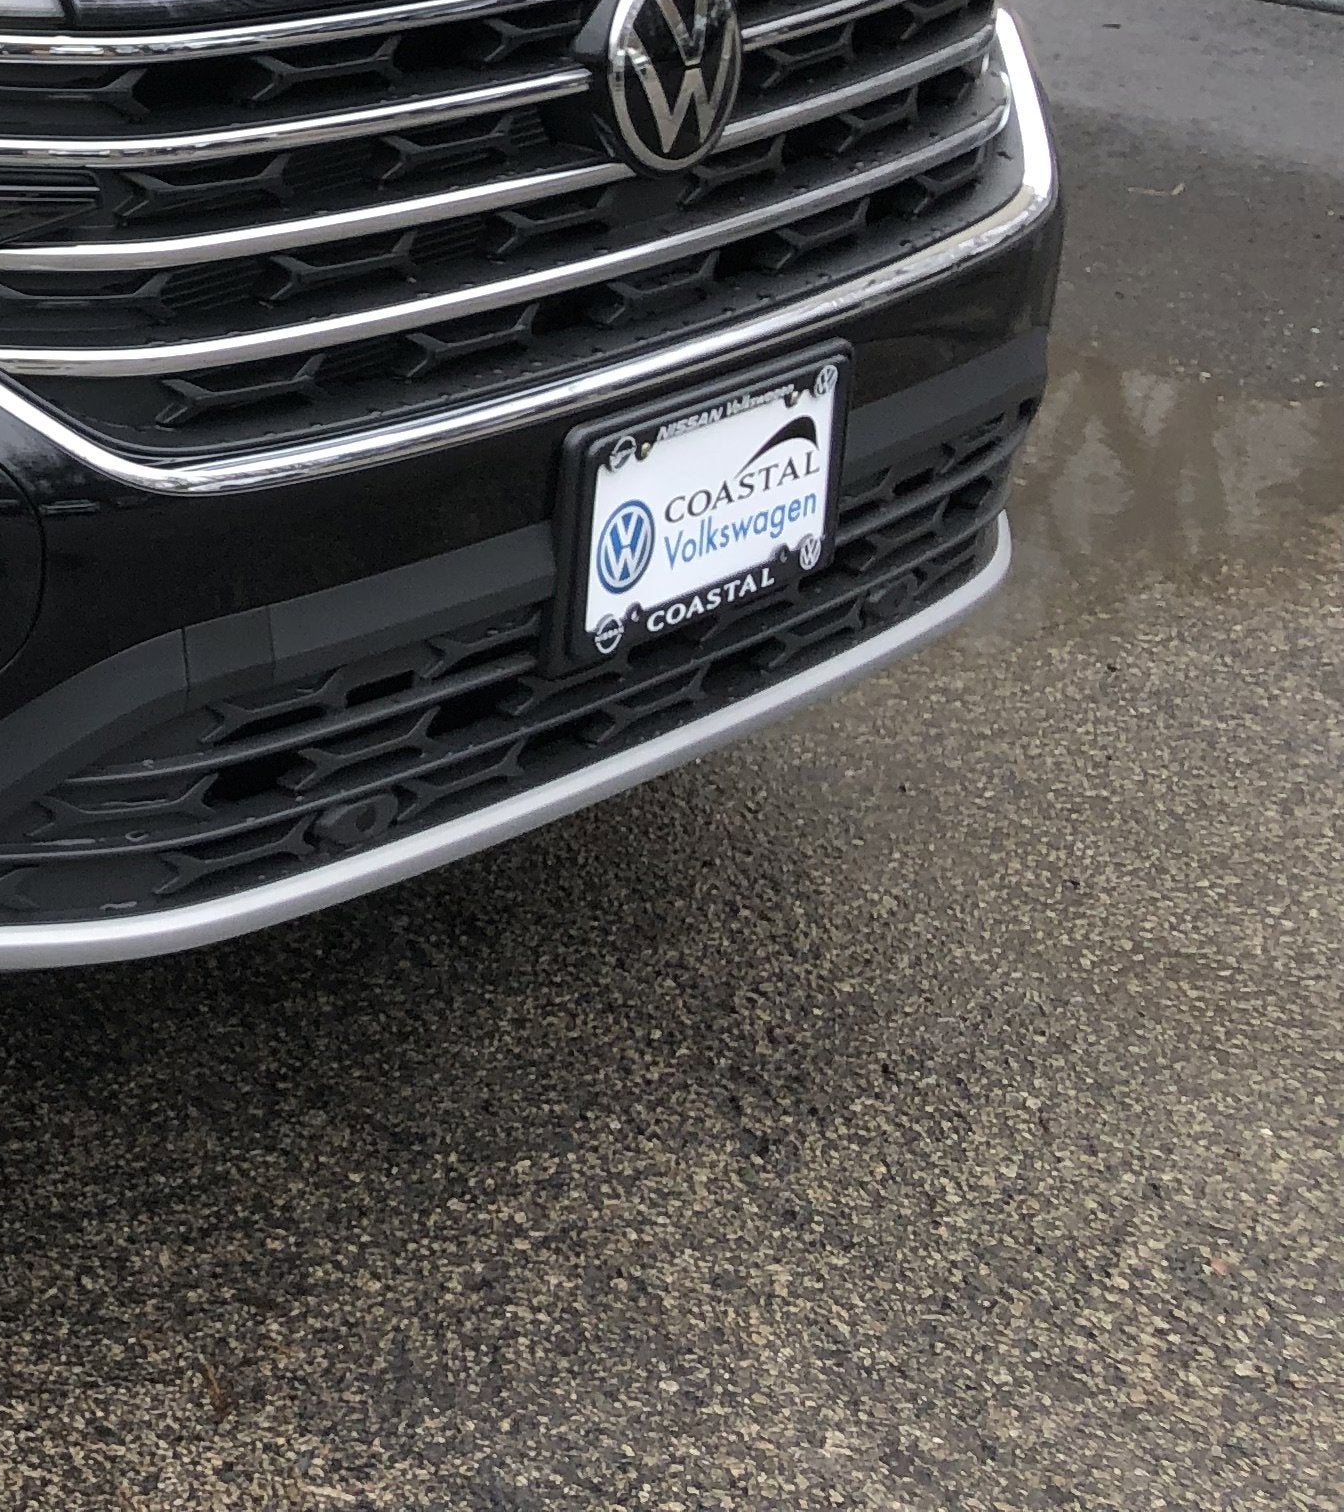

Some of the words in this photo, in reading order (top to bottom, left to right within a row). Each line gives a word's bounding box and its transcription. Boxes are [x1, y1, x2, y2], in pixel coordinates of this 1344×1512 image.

[657, 406, 723, 441] NISSAN
[664, 452, 820, 523] COASTAL
[664, 492, 817, 570] Volkswagen
[647, 568, 775, 632] COASTAL
